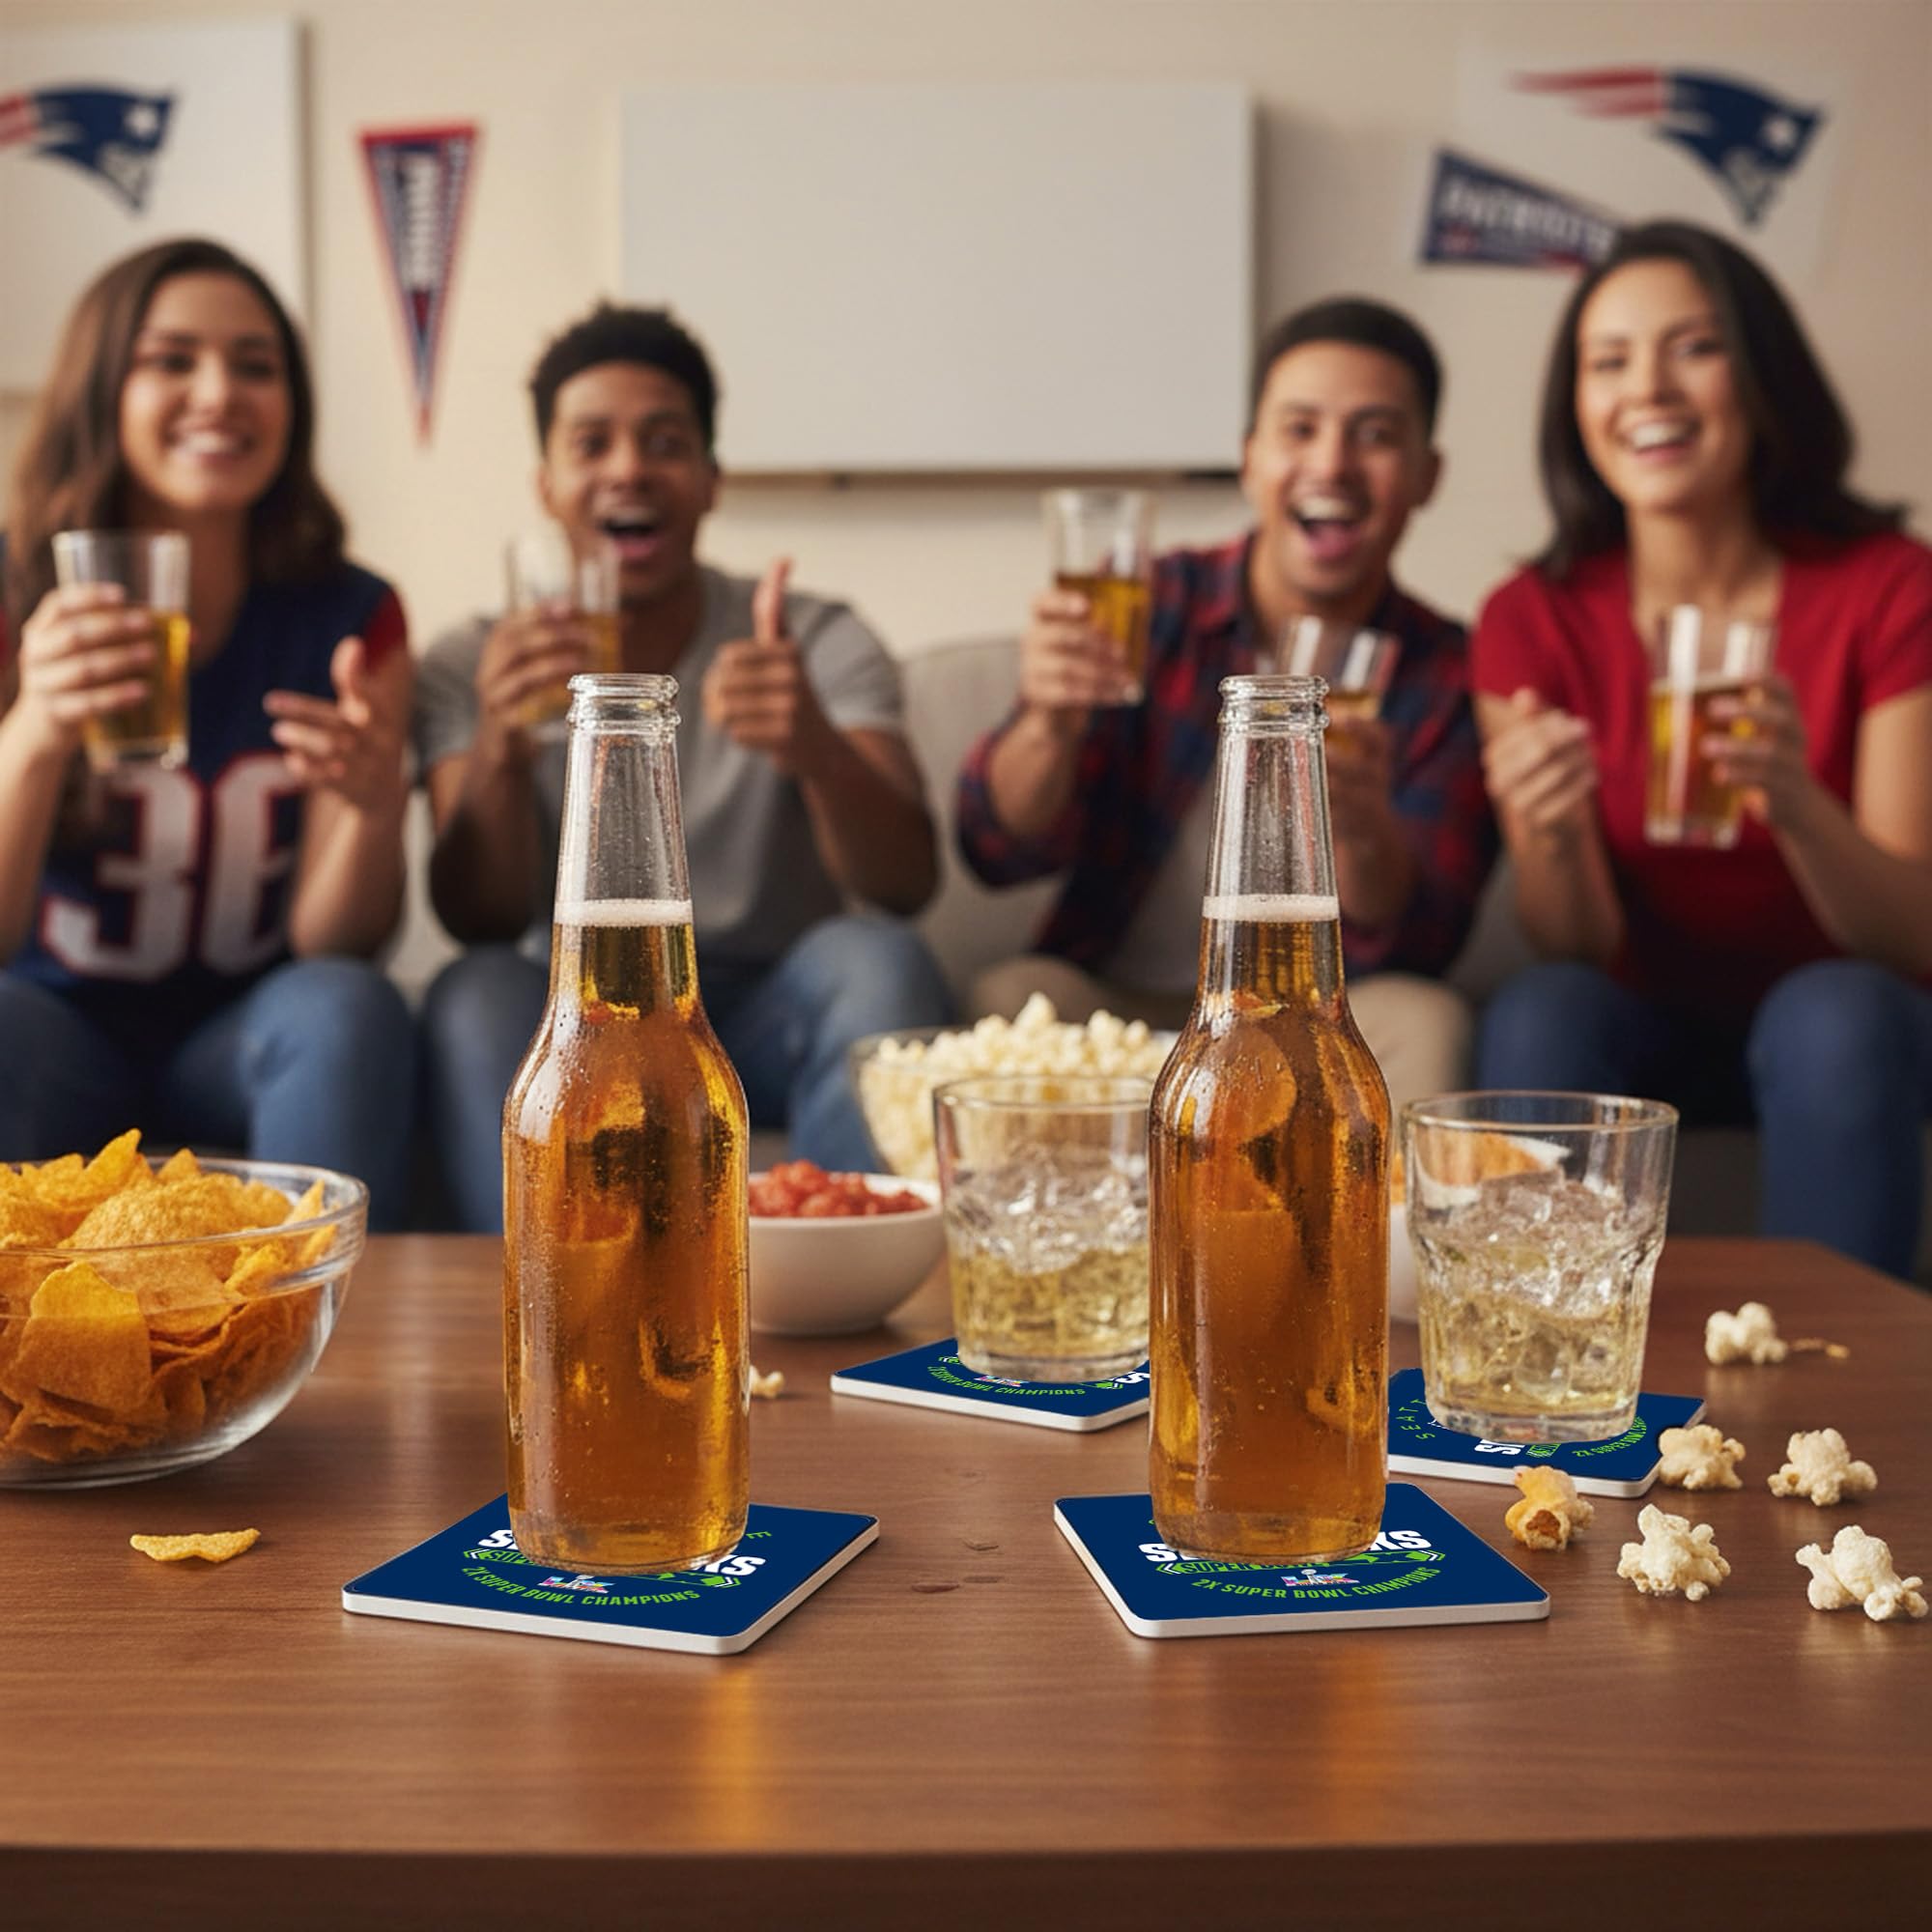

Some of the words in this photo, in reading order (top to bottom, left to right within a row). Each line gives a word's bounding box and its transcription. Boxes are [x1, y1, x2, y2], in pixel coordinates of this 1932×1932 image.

[995, 1387, 1086, 1396] CHAMPIONS
[473, 1573, 527, 1595] SUPER
[521, 1589, 576, 1605] BOWL
[582, 1590, 701, 1606] CHAMPIONS
[1191, 1578, 1224, 1590] 2X
[1221, 1583, 1288, 1599] SUPER
[1293, 1588, 1353, 1599] BOWL
[1351, 1567, 1441, 1595] CHAMPIONS
